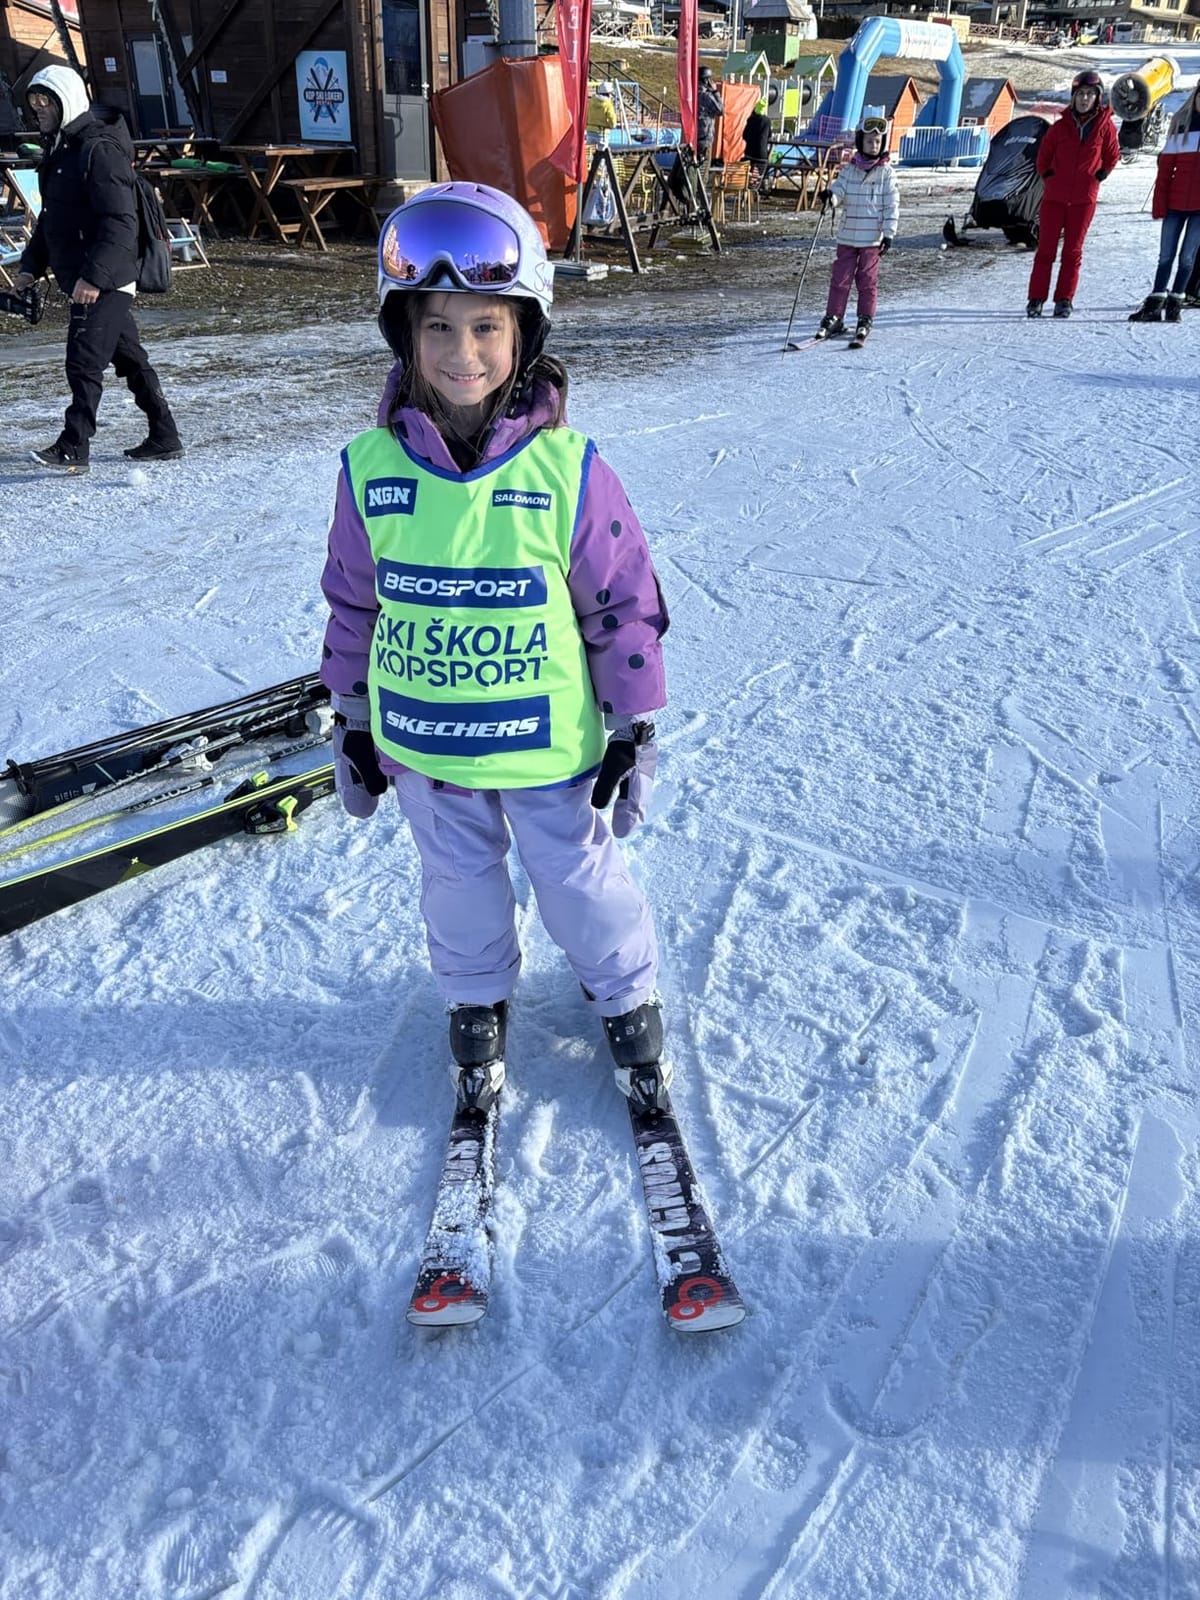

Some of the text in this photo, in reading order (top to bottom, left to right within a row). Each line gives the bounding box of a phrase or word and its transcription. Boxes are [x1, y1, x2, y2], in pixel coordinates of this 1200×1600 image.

[367, 485, 411, 507] NGN
[494, 493, 550, 507] SALOMON
[383, 571, 531, 598] BEOSPORT
[376, 612, 548, 656] SKI ŠKOLA
[376, 643, 549, 688] KOPSPORT
[385, 710, 540, 737] SKECHERS
